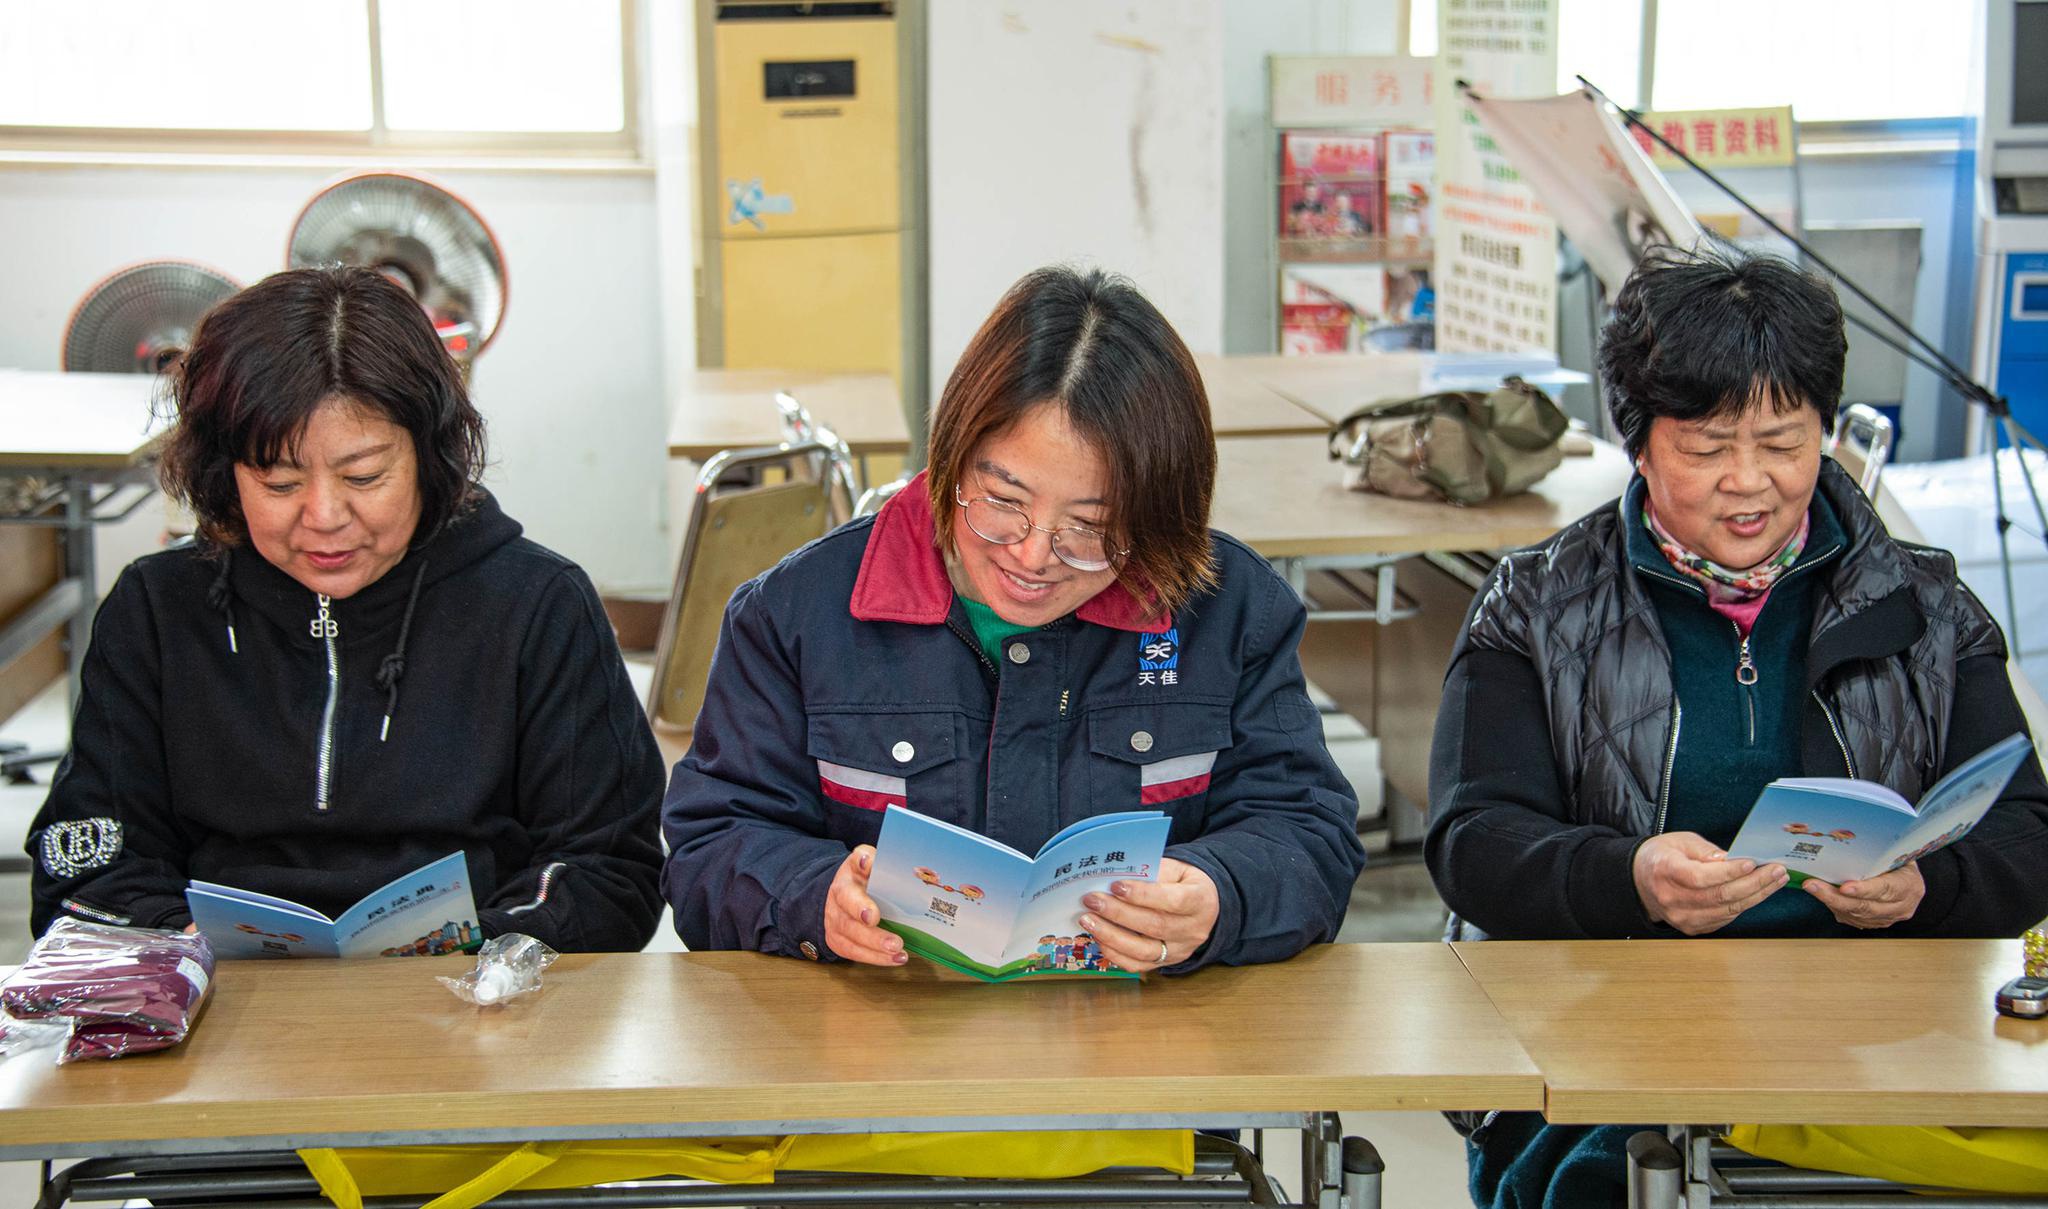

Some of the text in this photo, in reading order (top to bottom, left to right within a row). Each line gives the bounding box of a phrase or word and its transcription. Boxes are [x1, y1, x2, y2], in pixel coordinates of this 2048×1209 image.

[1138, 670, 1178, 686] 天佳
[1054, 850, 1126, 879] 民法典
